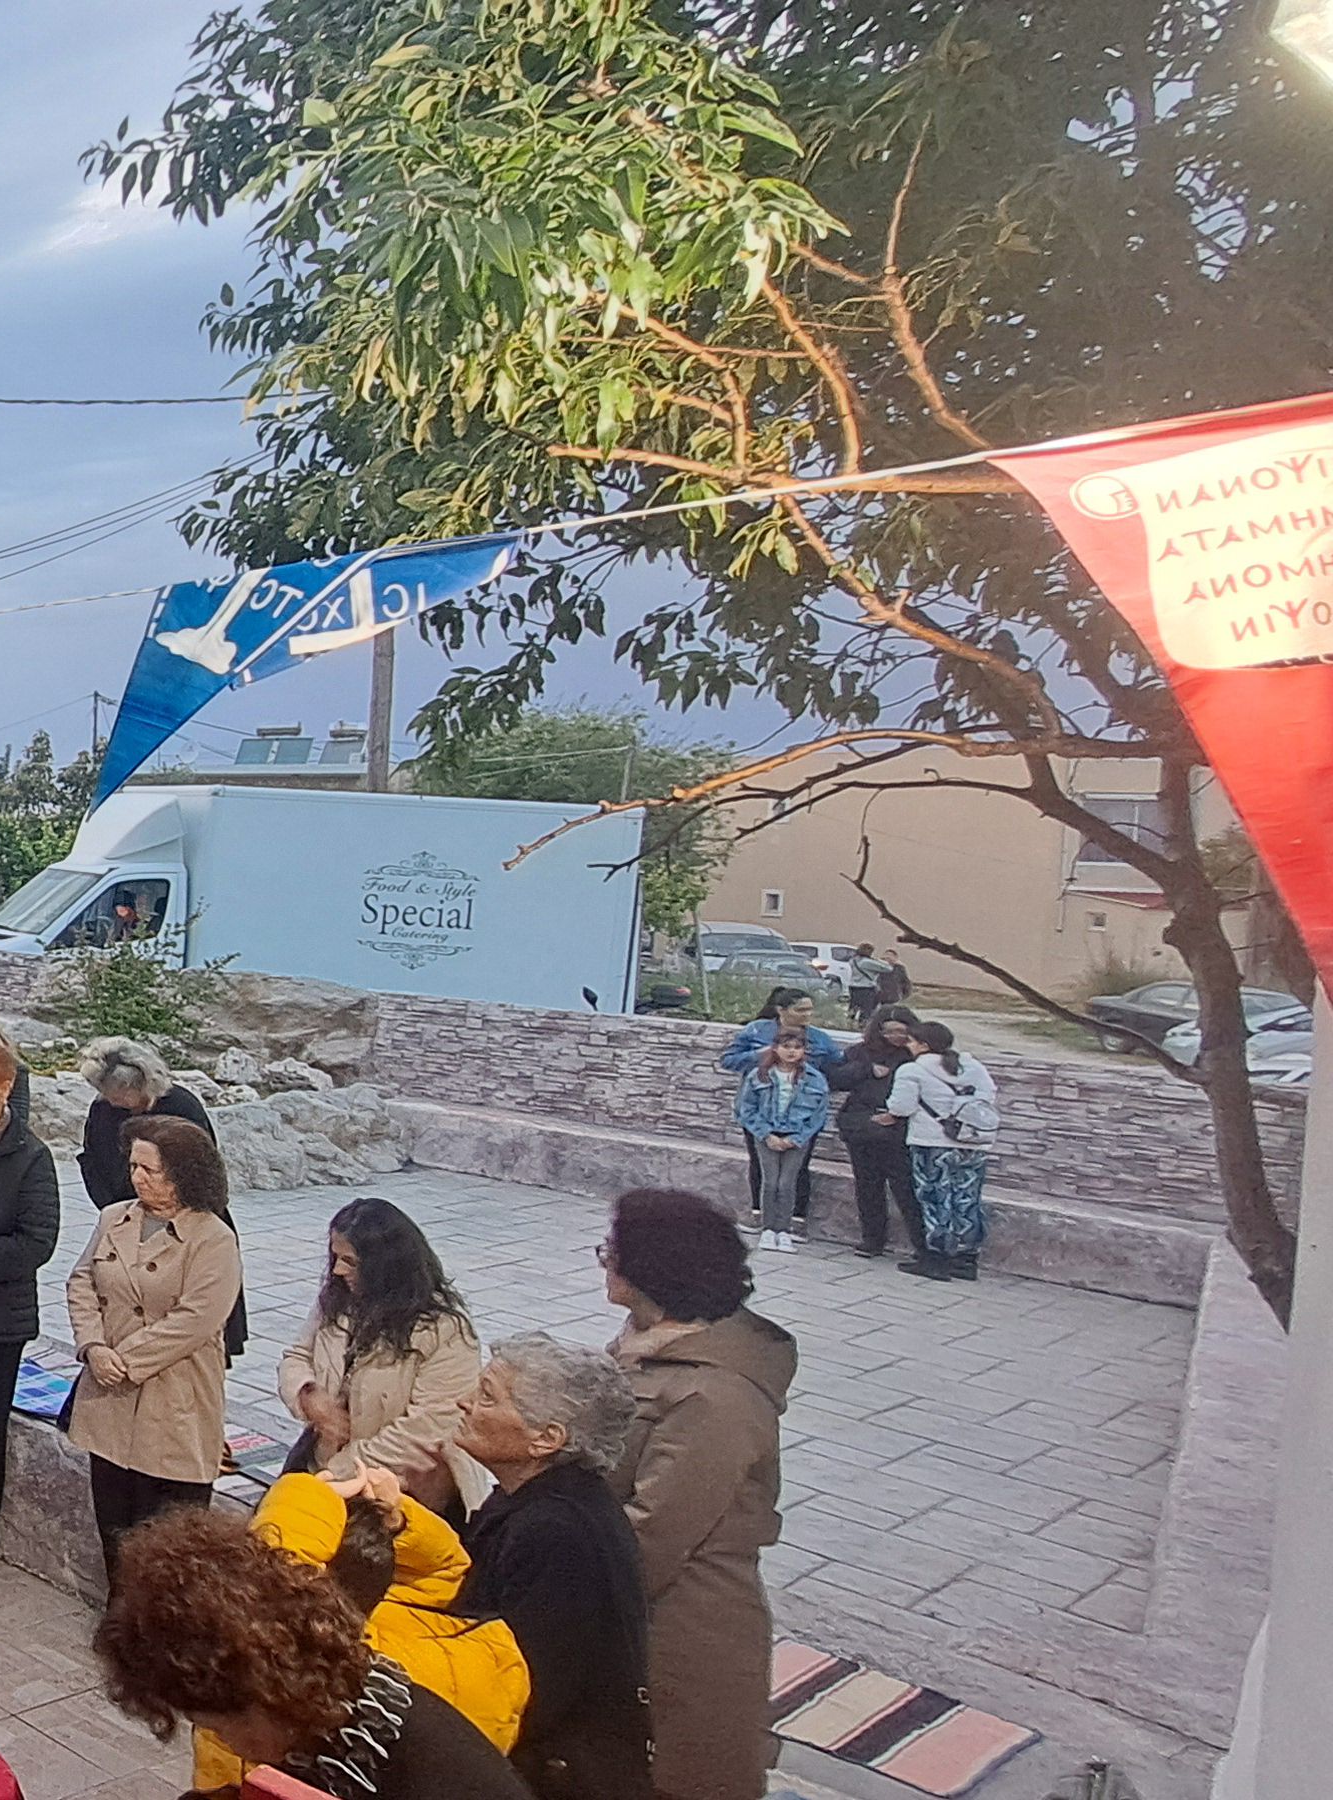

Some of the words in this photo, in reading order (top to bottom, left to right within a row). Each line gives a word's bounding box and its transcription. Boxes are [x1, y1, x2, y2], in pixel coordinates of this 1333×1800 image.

[362, 877, 411, 893] Food
[416, 883, 430, 893] &
[435, 882, 477, 900] Style
[361, 894, 473, 935] Special
[391, 926, 449, 943] Catering
